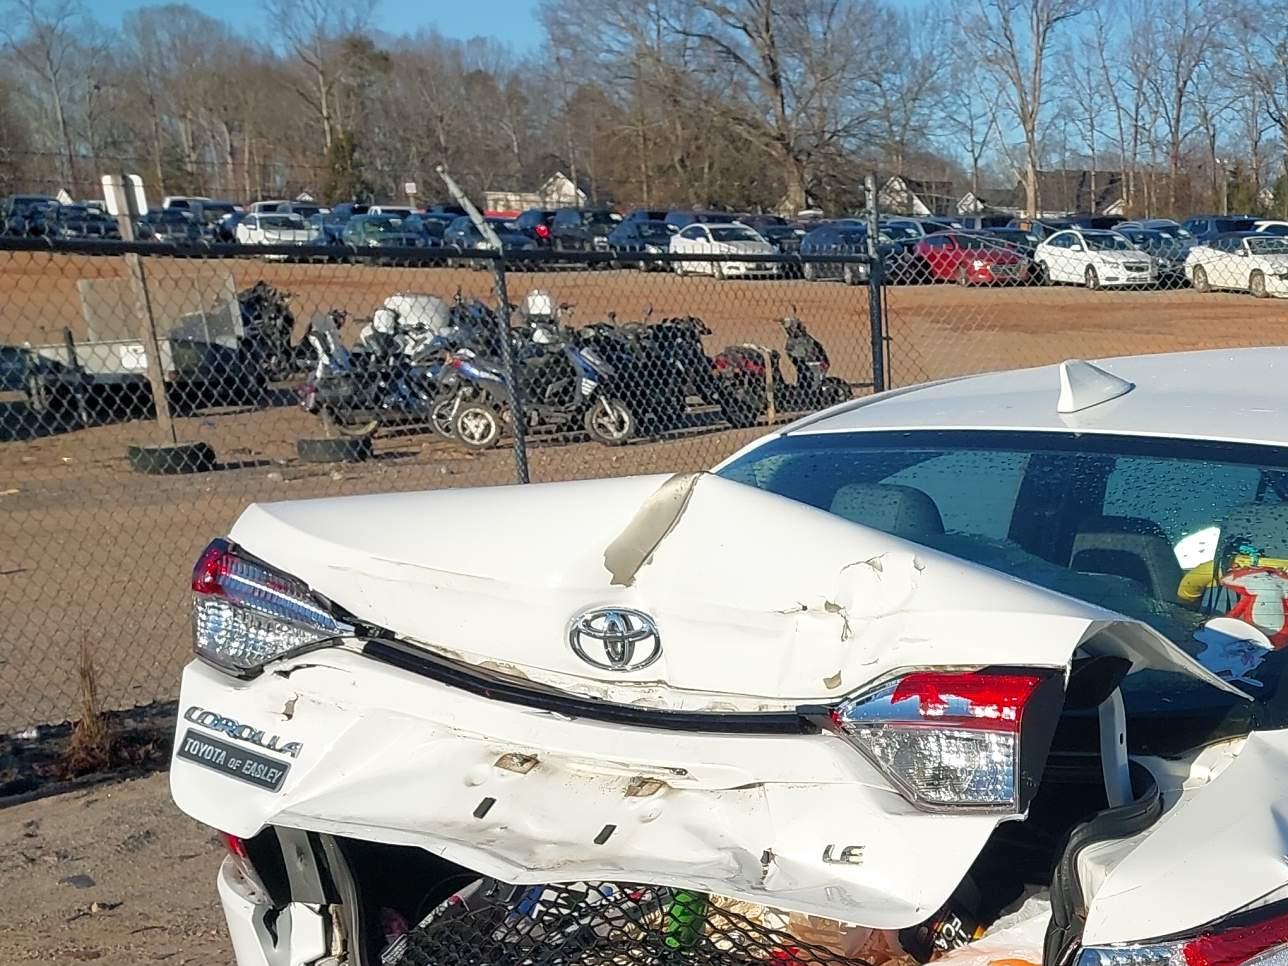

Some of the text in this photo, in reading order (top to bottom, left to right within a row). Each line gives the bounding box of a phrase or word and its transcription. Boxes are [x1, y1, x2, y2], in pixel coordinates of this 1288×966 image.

[184, 706, 304, 759] COROLLA
[184, 737, 283, 783] TOYOTA OF EASLEY
[822, 844, 866, 865] LE
